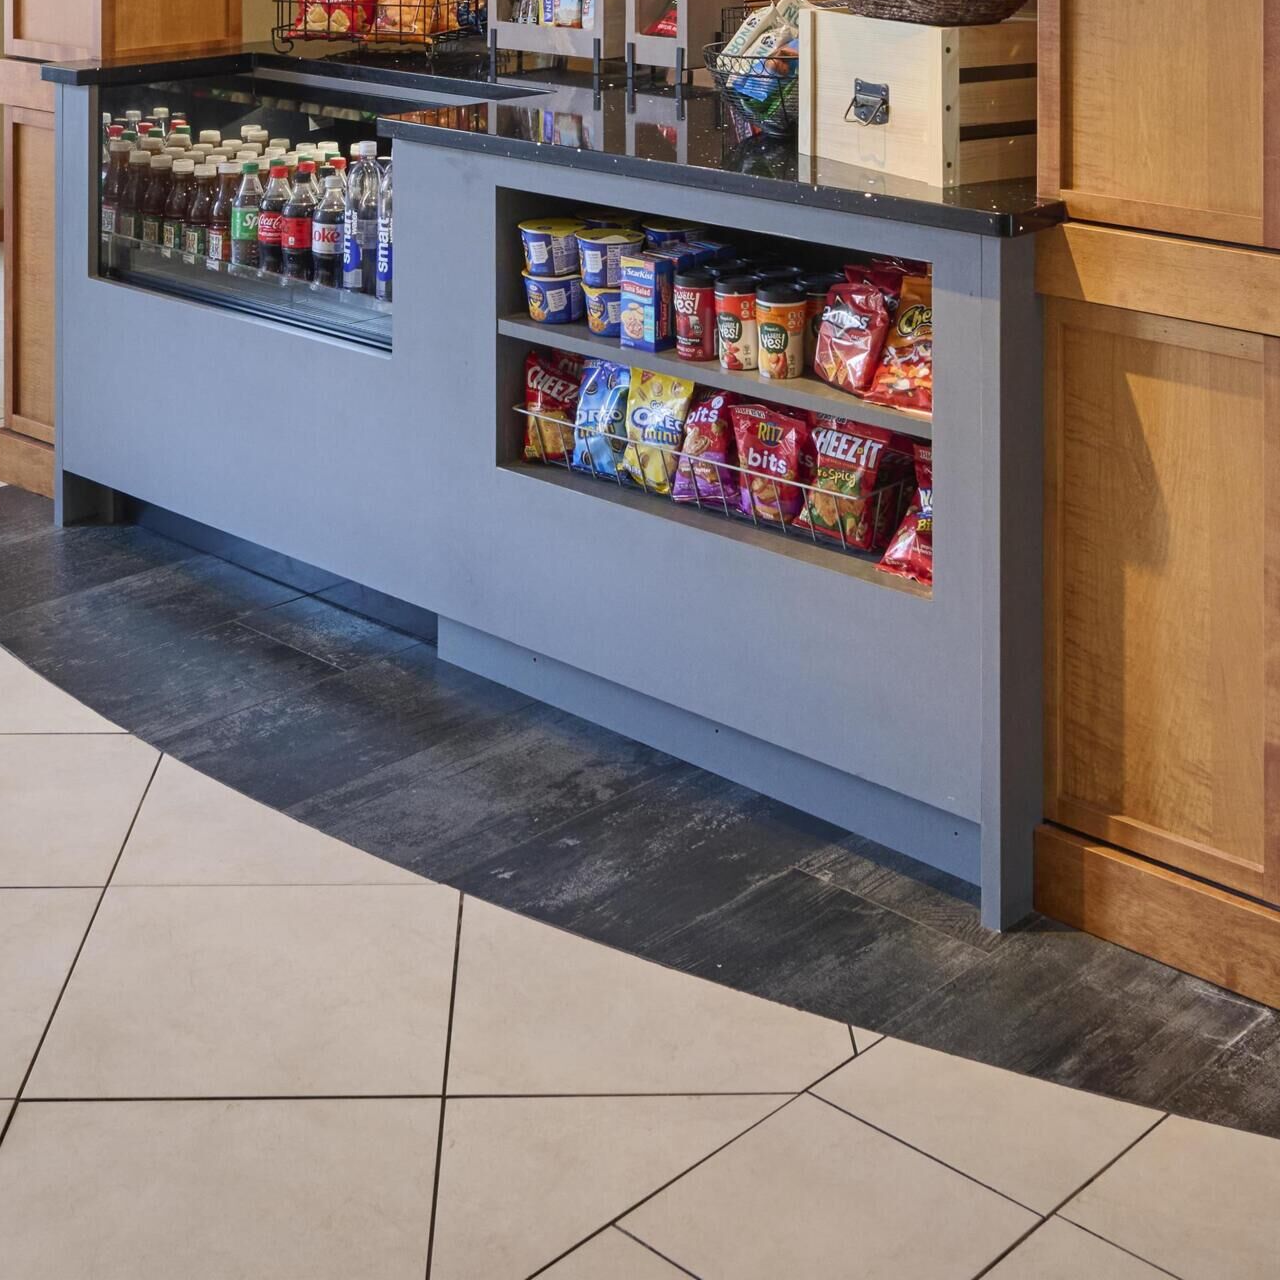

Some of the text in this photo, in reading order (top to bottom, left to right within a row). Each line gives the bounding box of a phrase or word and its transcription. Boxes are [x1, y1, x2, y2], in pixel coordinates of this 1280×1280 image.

[728, 26, 751, 55] NOR
[343, 209, 352, 265] smart
[377, 216, 389, 273] smart
[626, 268, 654, 280] StarKist
[761, 334, 785, 350] Yes!
[527, 366, 579, 403] CHEEZ
[642, 428, 681, 445] mini
[757, 422, 784, 442] RITZ
[748, 447, 788, 475] bits
[828, 469, 856, 487] Spicy
